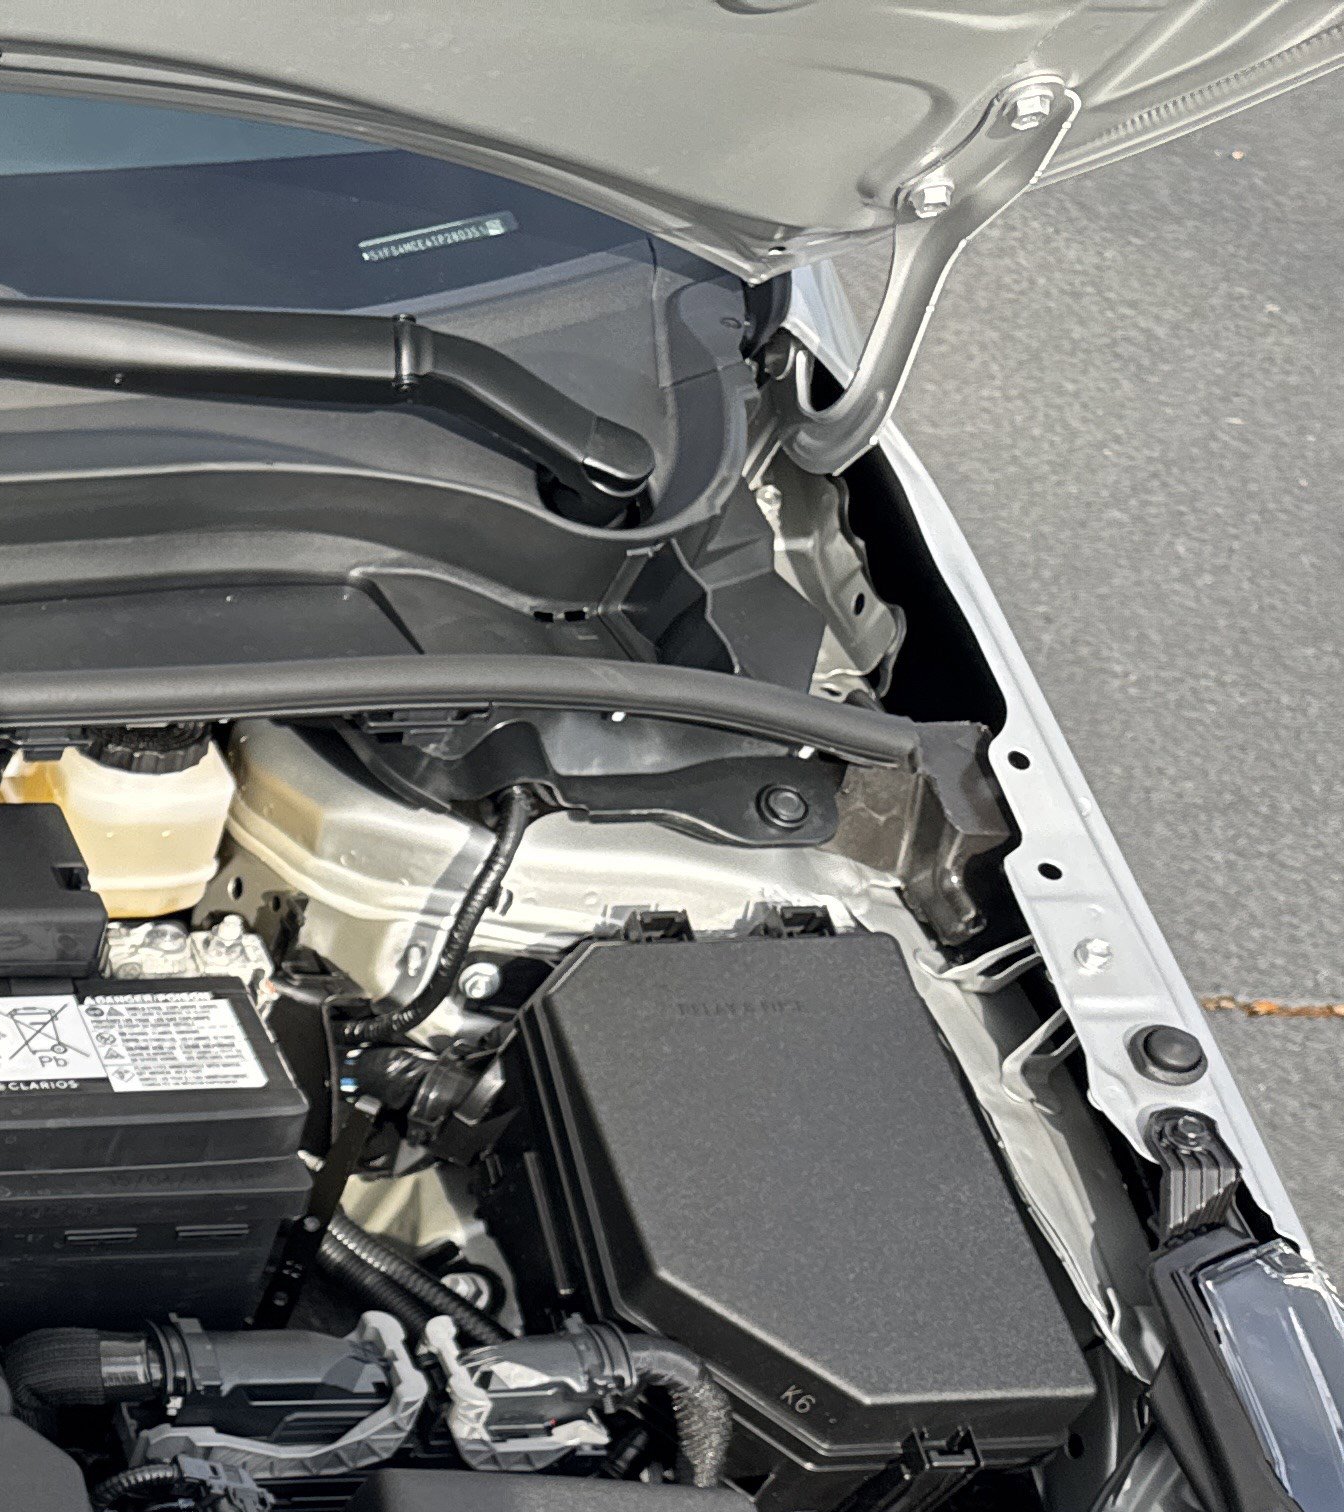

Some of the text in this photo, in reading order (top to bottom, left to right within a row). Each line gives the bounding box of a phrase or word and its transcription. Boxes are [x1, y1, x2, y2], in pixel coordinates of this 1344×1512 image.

[37, 1055, 68, 1068] Pb
[7, 1080, 80, 1091] CLARIOS
[779, 1384, 817, 1414] K6
